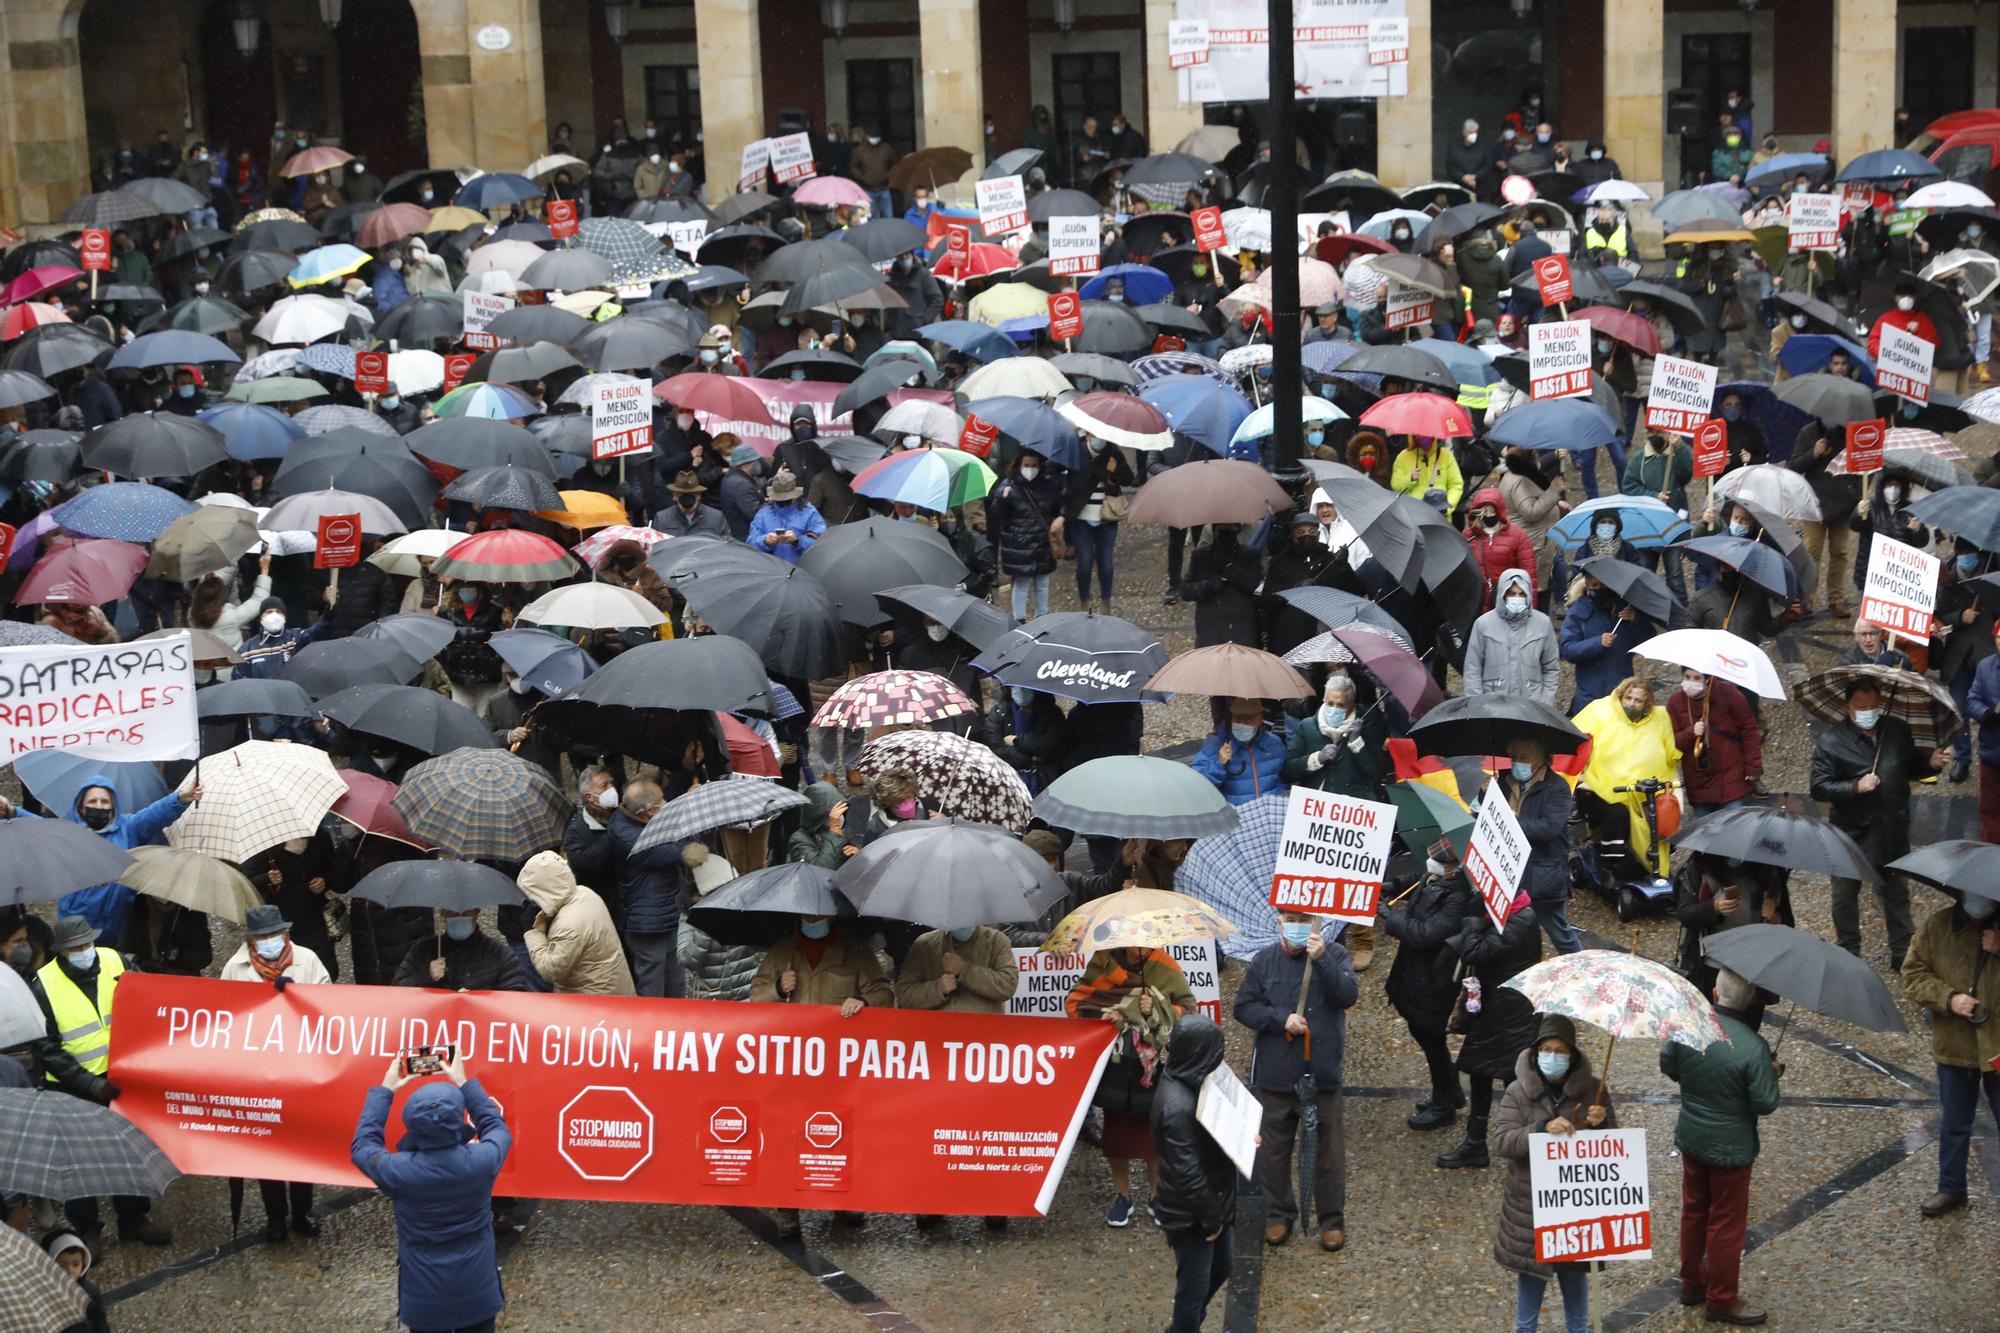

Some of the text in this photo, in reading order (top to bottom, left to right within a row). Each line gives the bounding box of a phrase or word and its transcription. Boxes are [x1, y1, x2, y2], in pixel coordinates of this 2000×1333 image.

[1052, 238, 1097, 248] DESPIERTA!
[1538, 329, 1550, 340] EN
[1544, 340, 1577, 354] MENOS
[1533, 352, 1589, 369] IMPOSICIÓN
[1663, 361, 1676, 373] EN
[601, 388, 613, 401] EN
[1534, 370, 1588, 399] BASTA YA!
[1666, 375, 1699, 393] MENOS
[607, 399, 638, 413] MENOS
[1652, 386, 1710, 409] IMPOSICIÓN
[595, 409, 649, 428] IMPOSICIÓN
[1648, 409, 1683, 428] BASTA
[596, 427, 649, 457] BASTA YA!
[1882, 542, 1897, 559] EN
[1886, 561, 1922, 587] MENOS
[1870, 571, 1932, 608] IMPOSICIÓN
[1865, 599, 1929, 634] BASTA YA!
[1037, 659, 1136, 689] Cleveland
[1063, 677, 1111, 691] GOLF
[0, 685, 184, 728] RADICALES
[1303, 797, 1378, 832] EN GIJÓN,
[1308, 822, 1366, 849] MENOS
[1487, 800, 1522, 867] ALCALDESA
[1283, 840, 1382, 876] IMPOSICIÓN
[1480, 815, 1516, 889] VETE A CASA
[1466, 847, 1509, 920] BASTA YA!
[1275, 879, 1375, 912] BASTA YA!
[1019, 956, 1038, 972] EN
[1010, 995, 1068, 1013] IMPOSI
[243, 1012, 284, 1052] LA
[297, 1014, 476, 1062] MOVILIDAD
[487, 1021, 530, 1064] EN
[541, 1019, 640, 1073] GIJÓN,
[652, 1030, 725, 1073] HAY
[735, 1033, 826, 1078] SITIO
[838, 1037, 931, 1081] PARA
[164, 1091, 283, 1110] CONTRA LA PEATONALIZACIÓN
[166, 1103, 181, 1114] DEL
[182, 1104, 204, 1116] MURO
[235, 1110, 246, 1120] EL
[179, 1121, 189, 1130] La
[190, 1122, 216, 1132] Ronda
[216, 1123, 240, 1134] Norte
[569, 1118, 642, 1139] STOPMURO
[933, 1128, 1058, 1144] CONTRA LA PEATONALIZACIÓN
[933, 1144, 949, 1156] DEL
[949, 1144, 974, 1157] MURO
[975, 1145, 981, 1156] Y
[981, 1145, 1006, 1157] AVDA.
[1007, 1146, 1018, 1157] EL
[1546, 1134, 1630, 1160] EN GIJÓN,
[947, 1162, 1044, 1174] La Ronda Norte de Gijón
[1559, 1162, 1620, 1184] MENOS
[1538, 1182, 1644, 1208] IMPOSICIÓN
[1541, 1216, 1644, 1260] BASTA YA!
